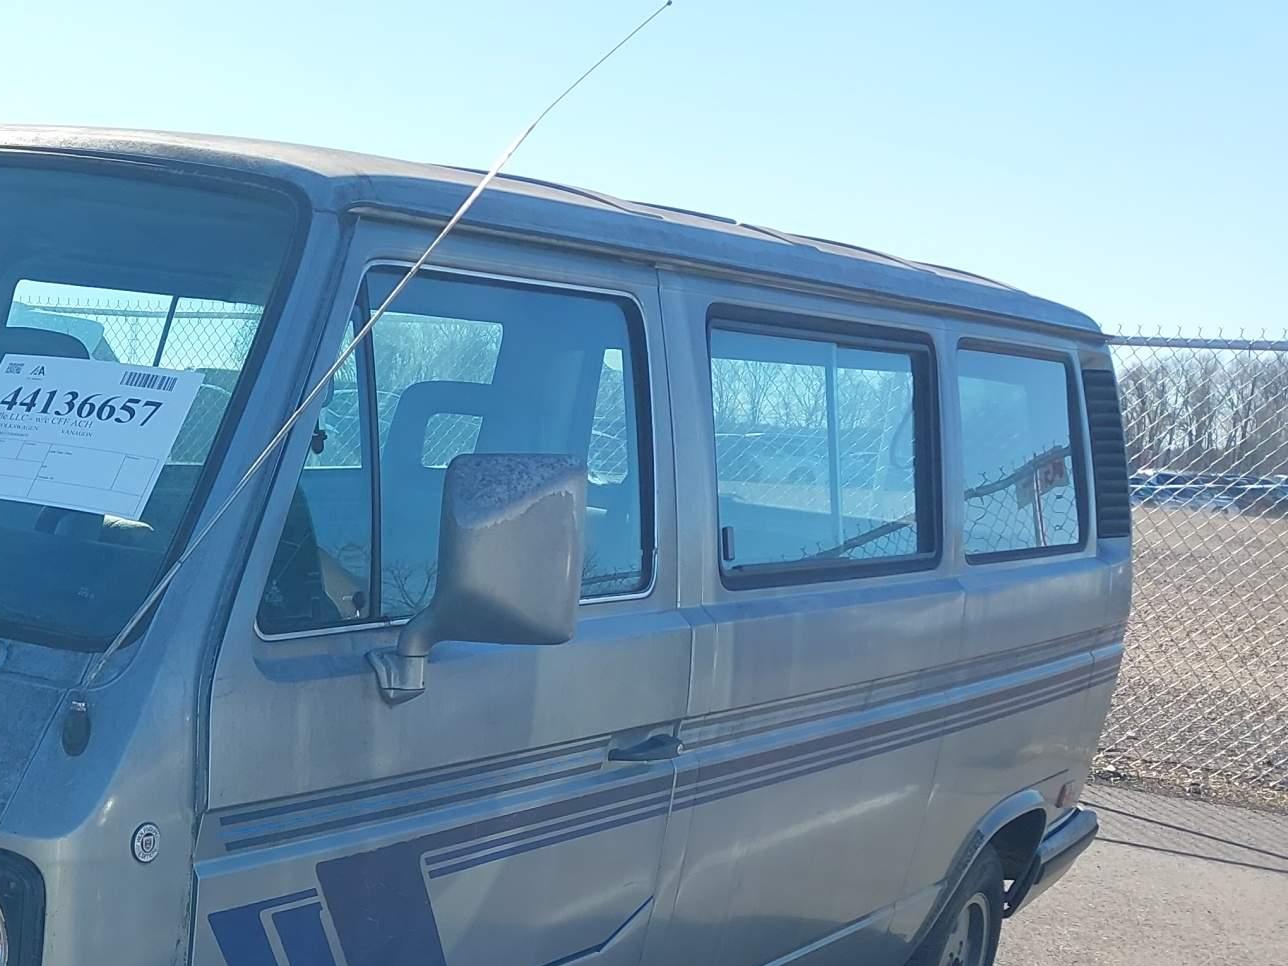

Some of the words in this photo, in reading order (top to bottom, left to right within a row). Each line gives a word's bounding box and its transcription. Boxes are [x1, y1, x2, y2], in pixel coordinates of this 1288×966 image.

[0, 386, 163, 427] 44136657
[9, 413, 29, 422] LLC
[71, 419, 93, 429] ACH
